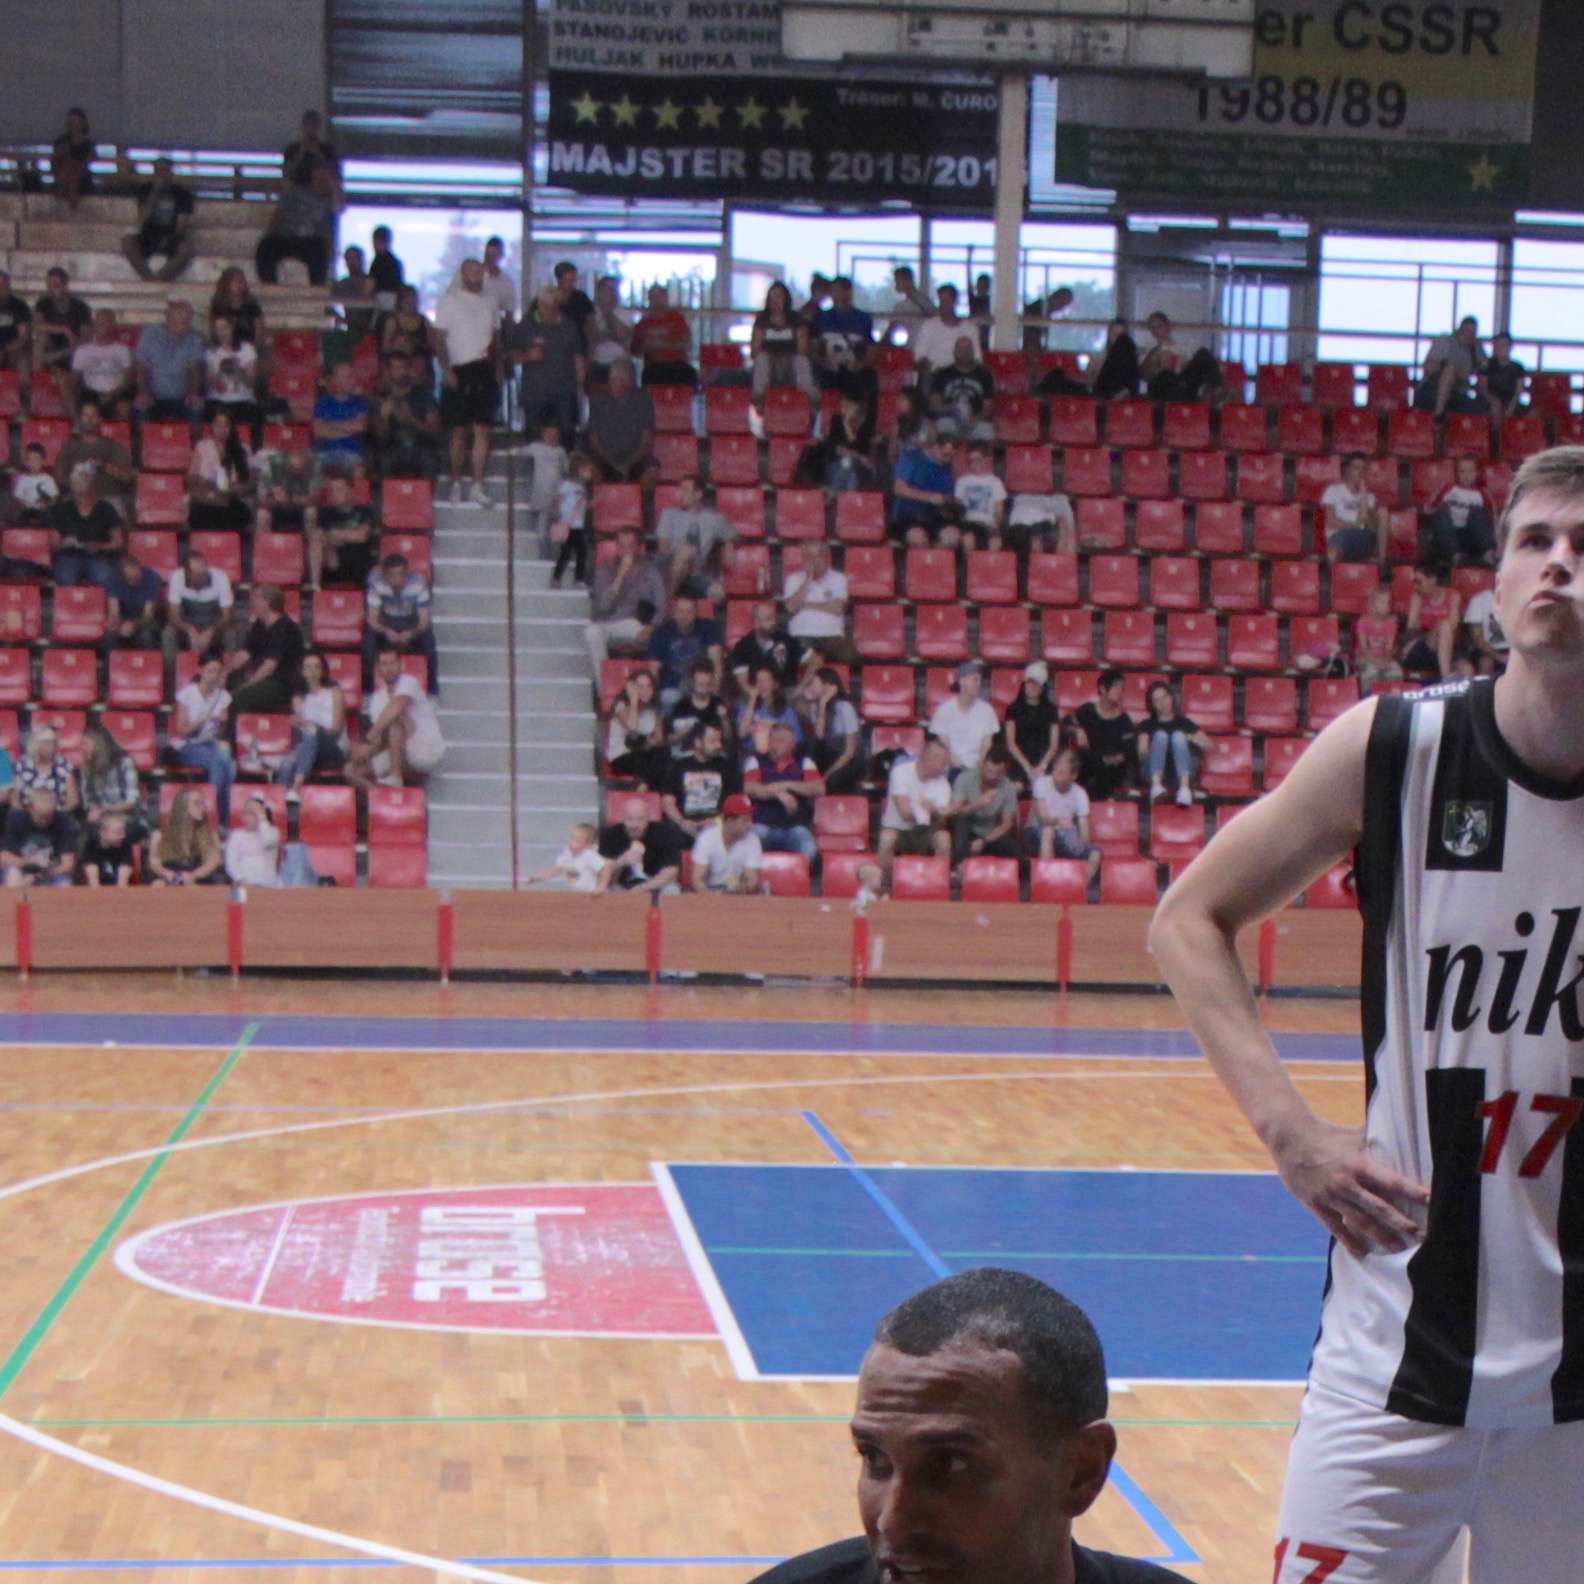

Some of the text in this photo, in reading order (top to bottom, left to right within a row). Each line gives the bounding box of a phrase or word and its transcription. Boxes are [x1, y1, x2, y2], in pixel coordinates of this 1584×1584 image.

[1196, 75, 1408, 130] 1988/89
[549, 142, 999, 188] MAJSTER SR 2015/201
